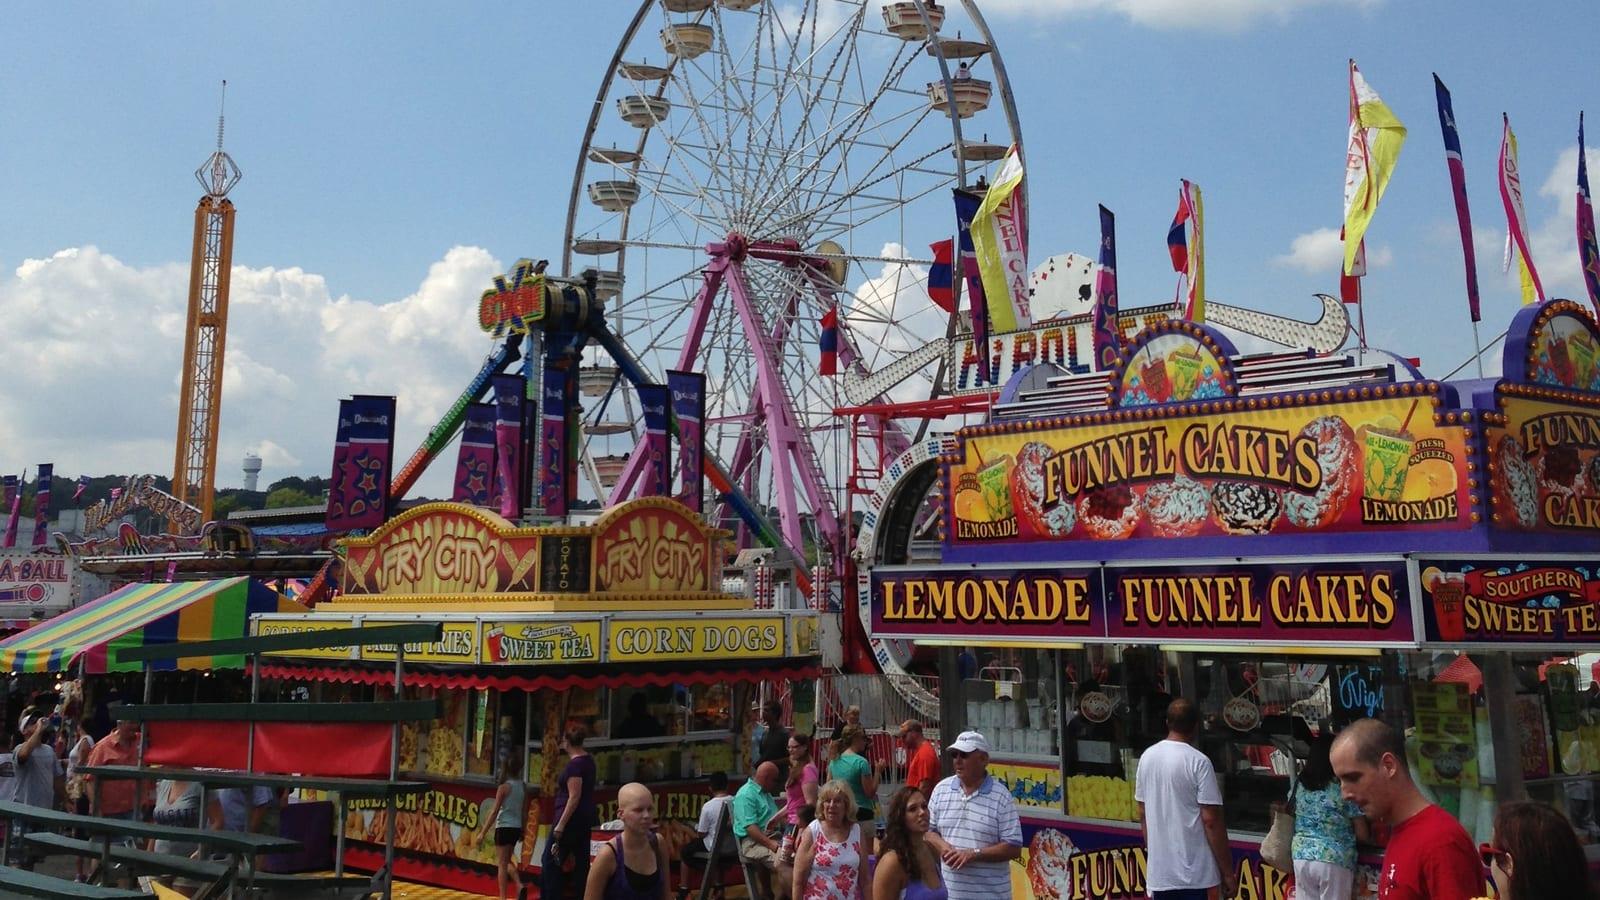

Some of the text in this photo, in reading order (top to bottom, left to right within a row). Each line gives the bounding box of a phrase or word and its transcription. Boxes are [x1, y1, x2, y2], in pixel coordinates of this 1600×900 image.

[1009, 259, 1030, 318] CAKE
[1046, 422, 1321, 503] FUNNEL CAKES
[1409, 451, 1454, 465] SQUEEZED
[1417, 439, 1444, 450] FRESH
[1362, 495, 1458, 521] LEMONADE
[957, 517, 1019, 538] LEMONADE
[381, 535, 496, 588] FRY CITY
[560, 537, 570, 588] POTATO
[605, 536, 704, 588] FRY CITY
[882, 579, 1090, 622] LEMONADE
[1122, 574, 1395, 625] FUNNEL CAKES
[1486, 572, 1582, 597] SOUTHERN
[1465, 595, 1600, 632] SWEET TE
[500, 634, 593, 660] SWEET TEA
[616, 626, 777, 654] CORN DOGS
[423, 790, 479, 829] FRIES
